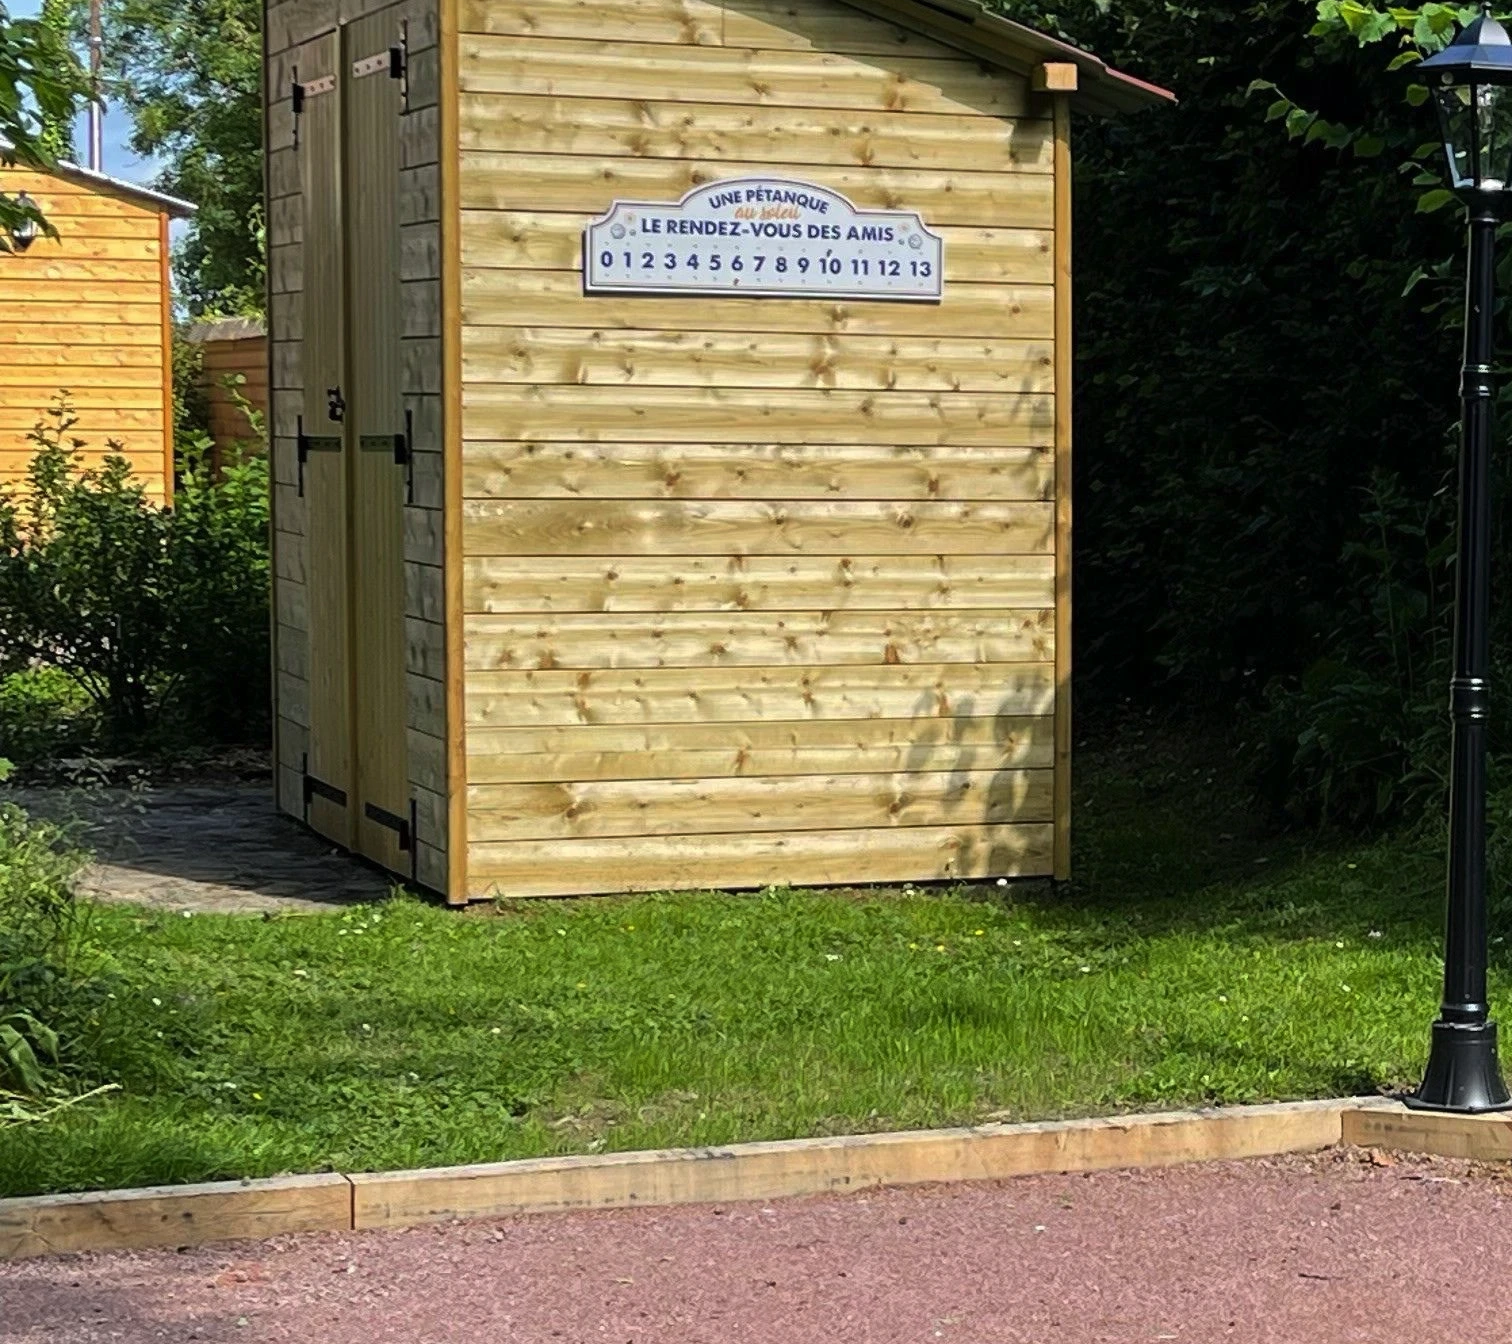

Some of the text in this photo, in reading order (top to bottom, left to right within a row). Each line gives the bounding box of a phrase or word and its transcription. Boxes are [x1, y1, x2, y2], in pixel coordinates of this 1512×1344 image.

[708, 185, 830, 215] UNE PÉTANQUE
[733, 205, 757, 220] au
[641, 217, 895, 242] LE RENDEZ-VOUS DES AMIS
[600, 250, 932, 278] 0 1 2 3 4 5 6 7 8 9 10 11 12 13
